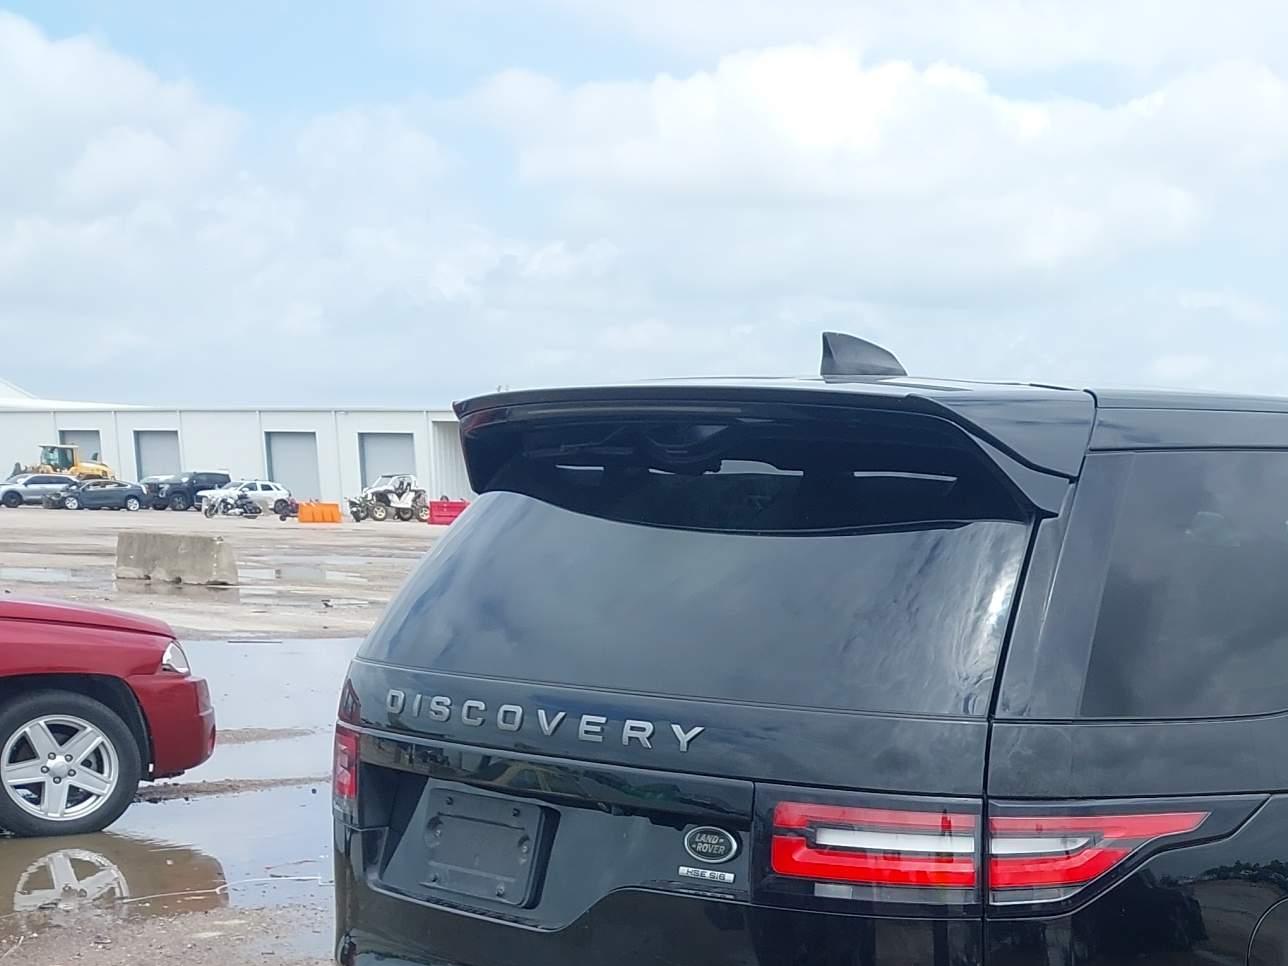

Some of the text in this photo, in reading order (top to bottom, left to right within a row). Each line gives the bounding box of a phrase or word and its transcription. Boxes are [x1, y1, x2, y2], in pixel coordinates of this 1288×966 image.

[386, 688, 705, 752] DISCOVERY
[695, 833, 720, 844] LAND
[696, 842, 726, 855] ROVER
[686, 868, 707, 878] HSE
